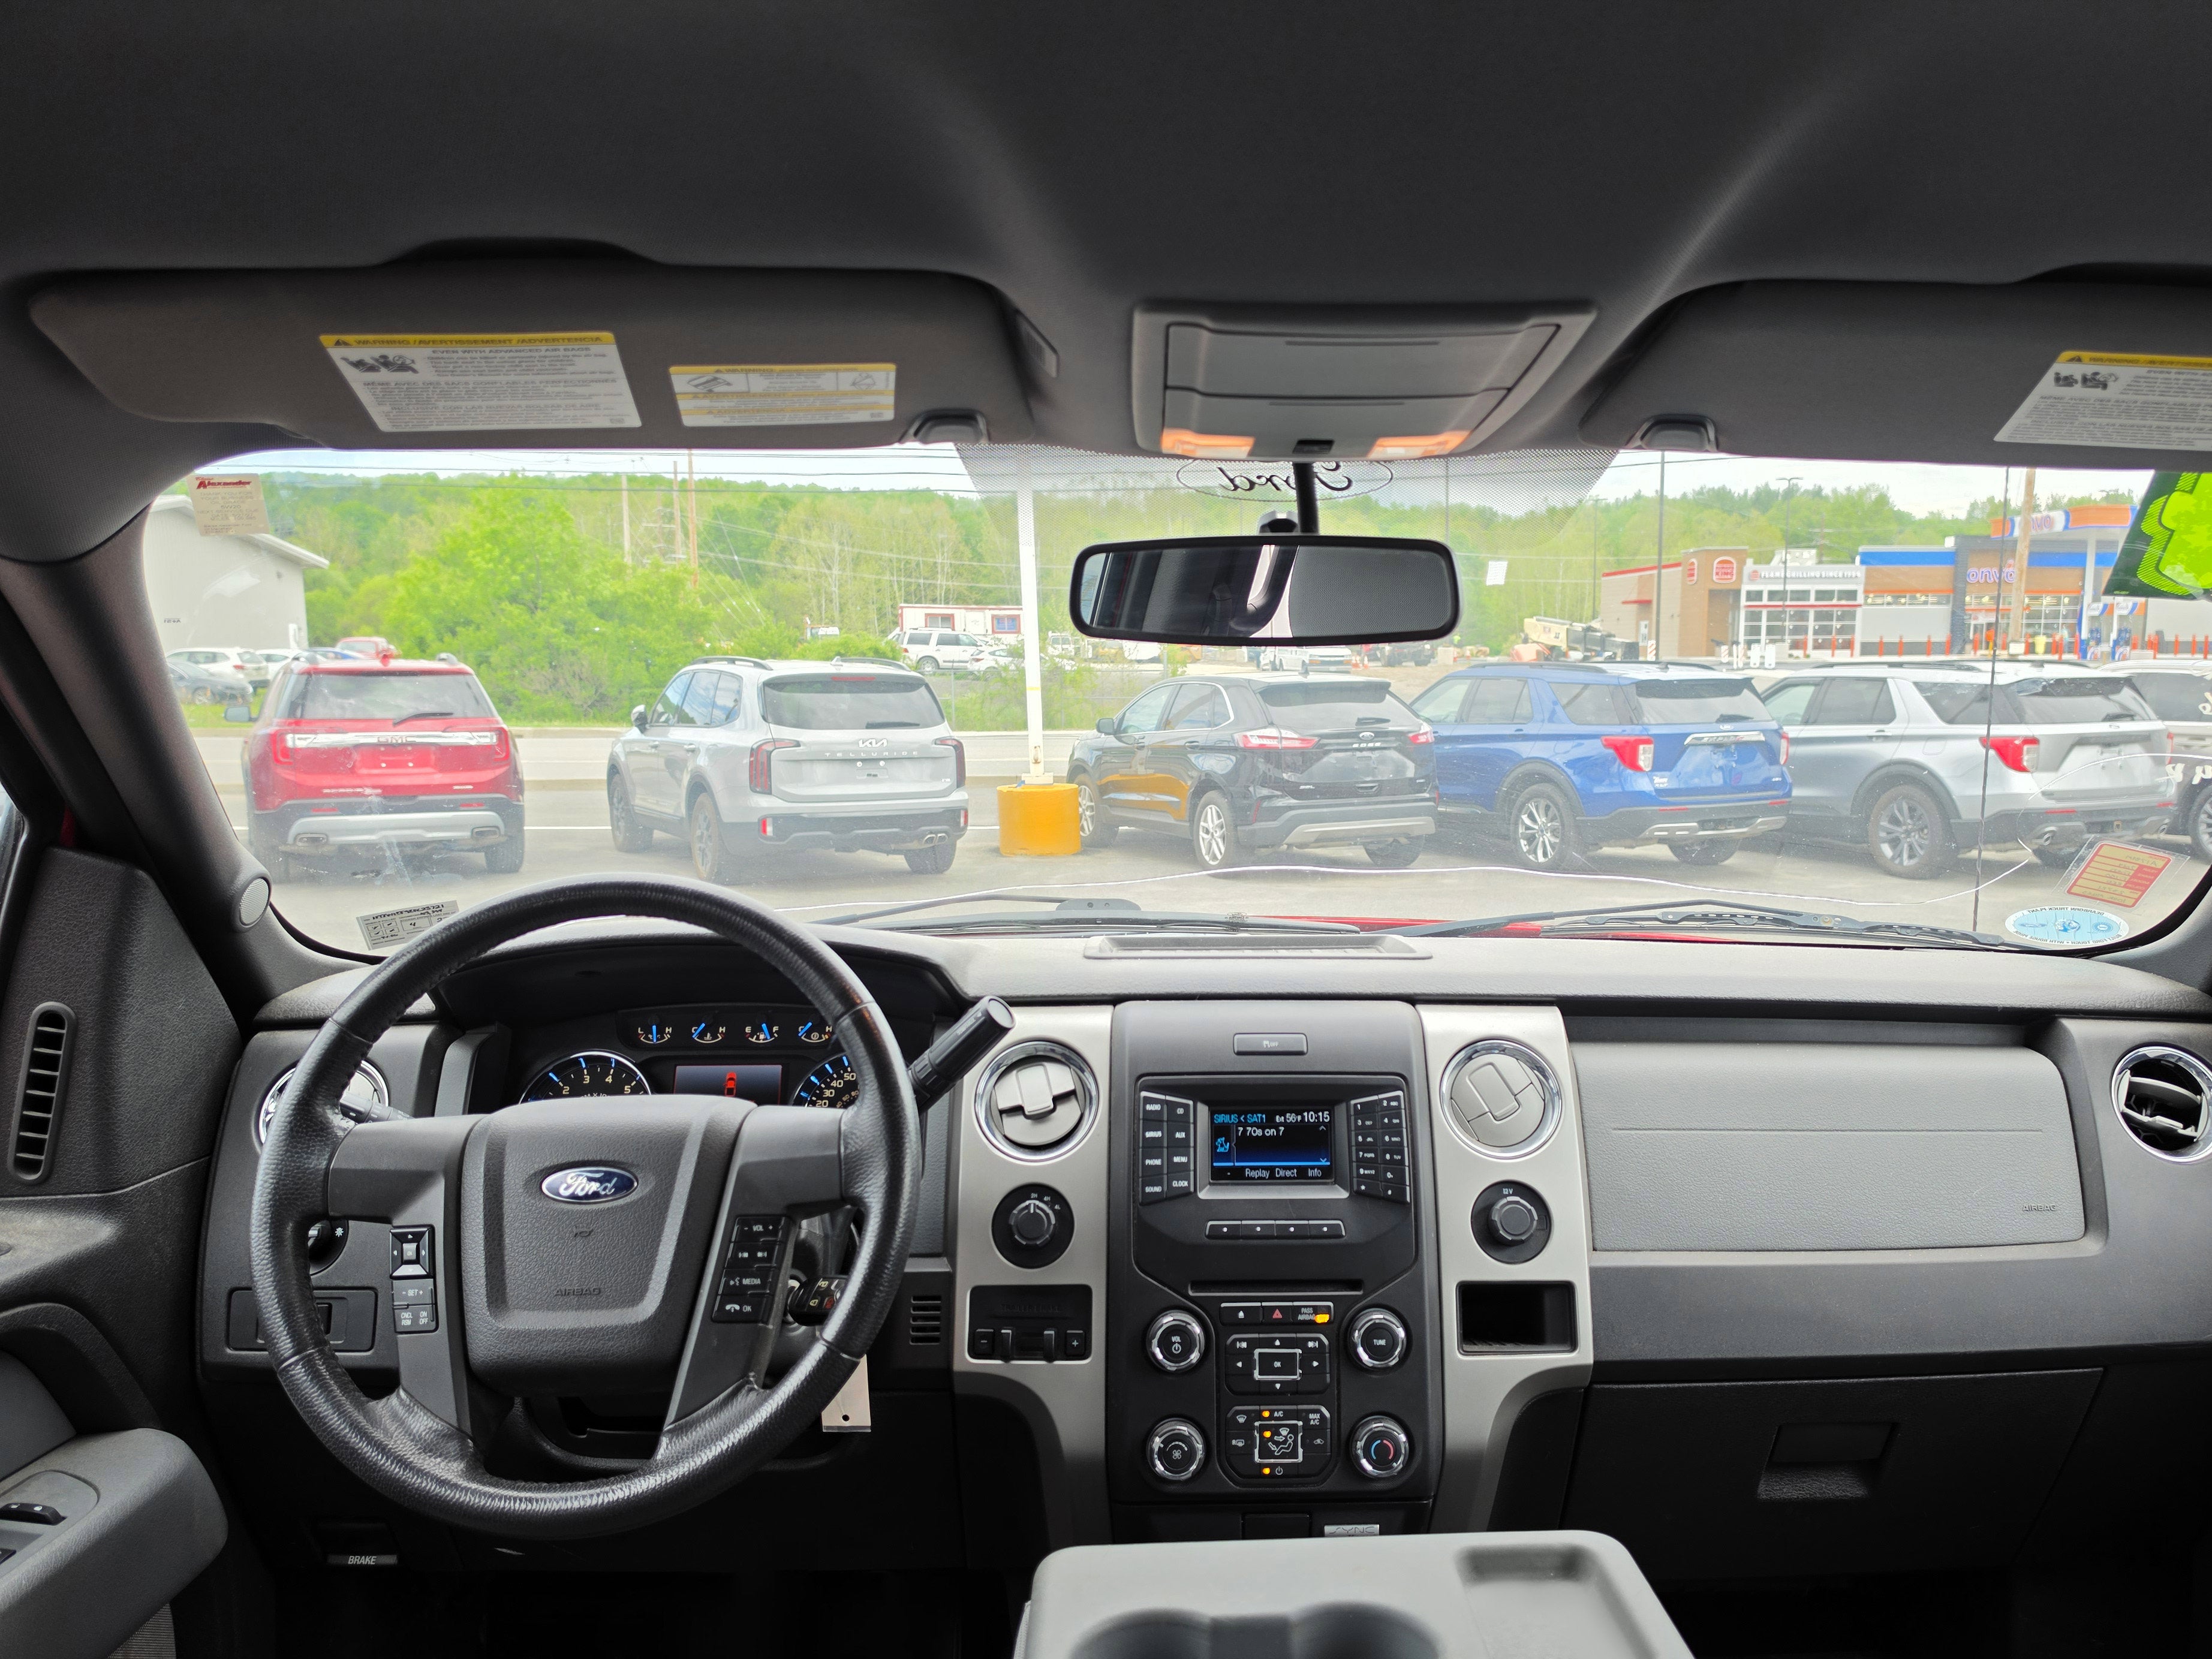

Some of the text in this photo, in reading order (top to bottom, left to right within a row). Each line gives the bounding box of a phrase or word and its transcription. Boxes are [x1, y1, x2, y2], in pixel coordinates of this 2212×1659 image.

[196, 480, 252, 489] Alexander
[583, 1075, 590, 1084] 3
[605, 1075, 613, 1083] 4
[562, 1086, 570, 1095] 2
[624, 1085, 631, 1094] 5
[1214, 1113, 1238, 1124] SIRIUS
[1247, 1113, 1266, 1123] SAT1
[1303, 1111, 1330, 1123] 10:15
[1238, 1127, 1244, 1136] 7
[1246, 1127, 1263, 1136] 70s
[1279, 1127, 1285, 1136] 7
[1245, 1167, 1322, 1179] Replay Direct Info
[558, 1172, 618, 1197] Ford
[555, 1287, 601, 1296] AIRBAG
[1329, 1526, 1376, 1535] SYNC
[348, 1555, 377, 1565] BRAKE
